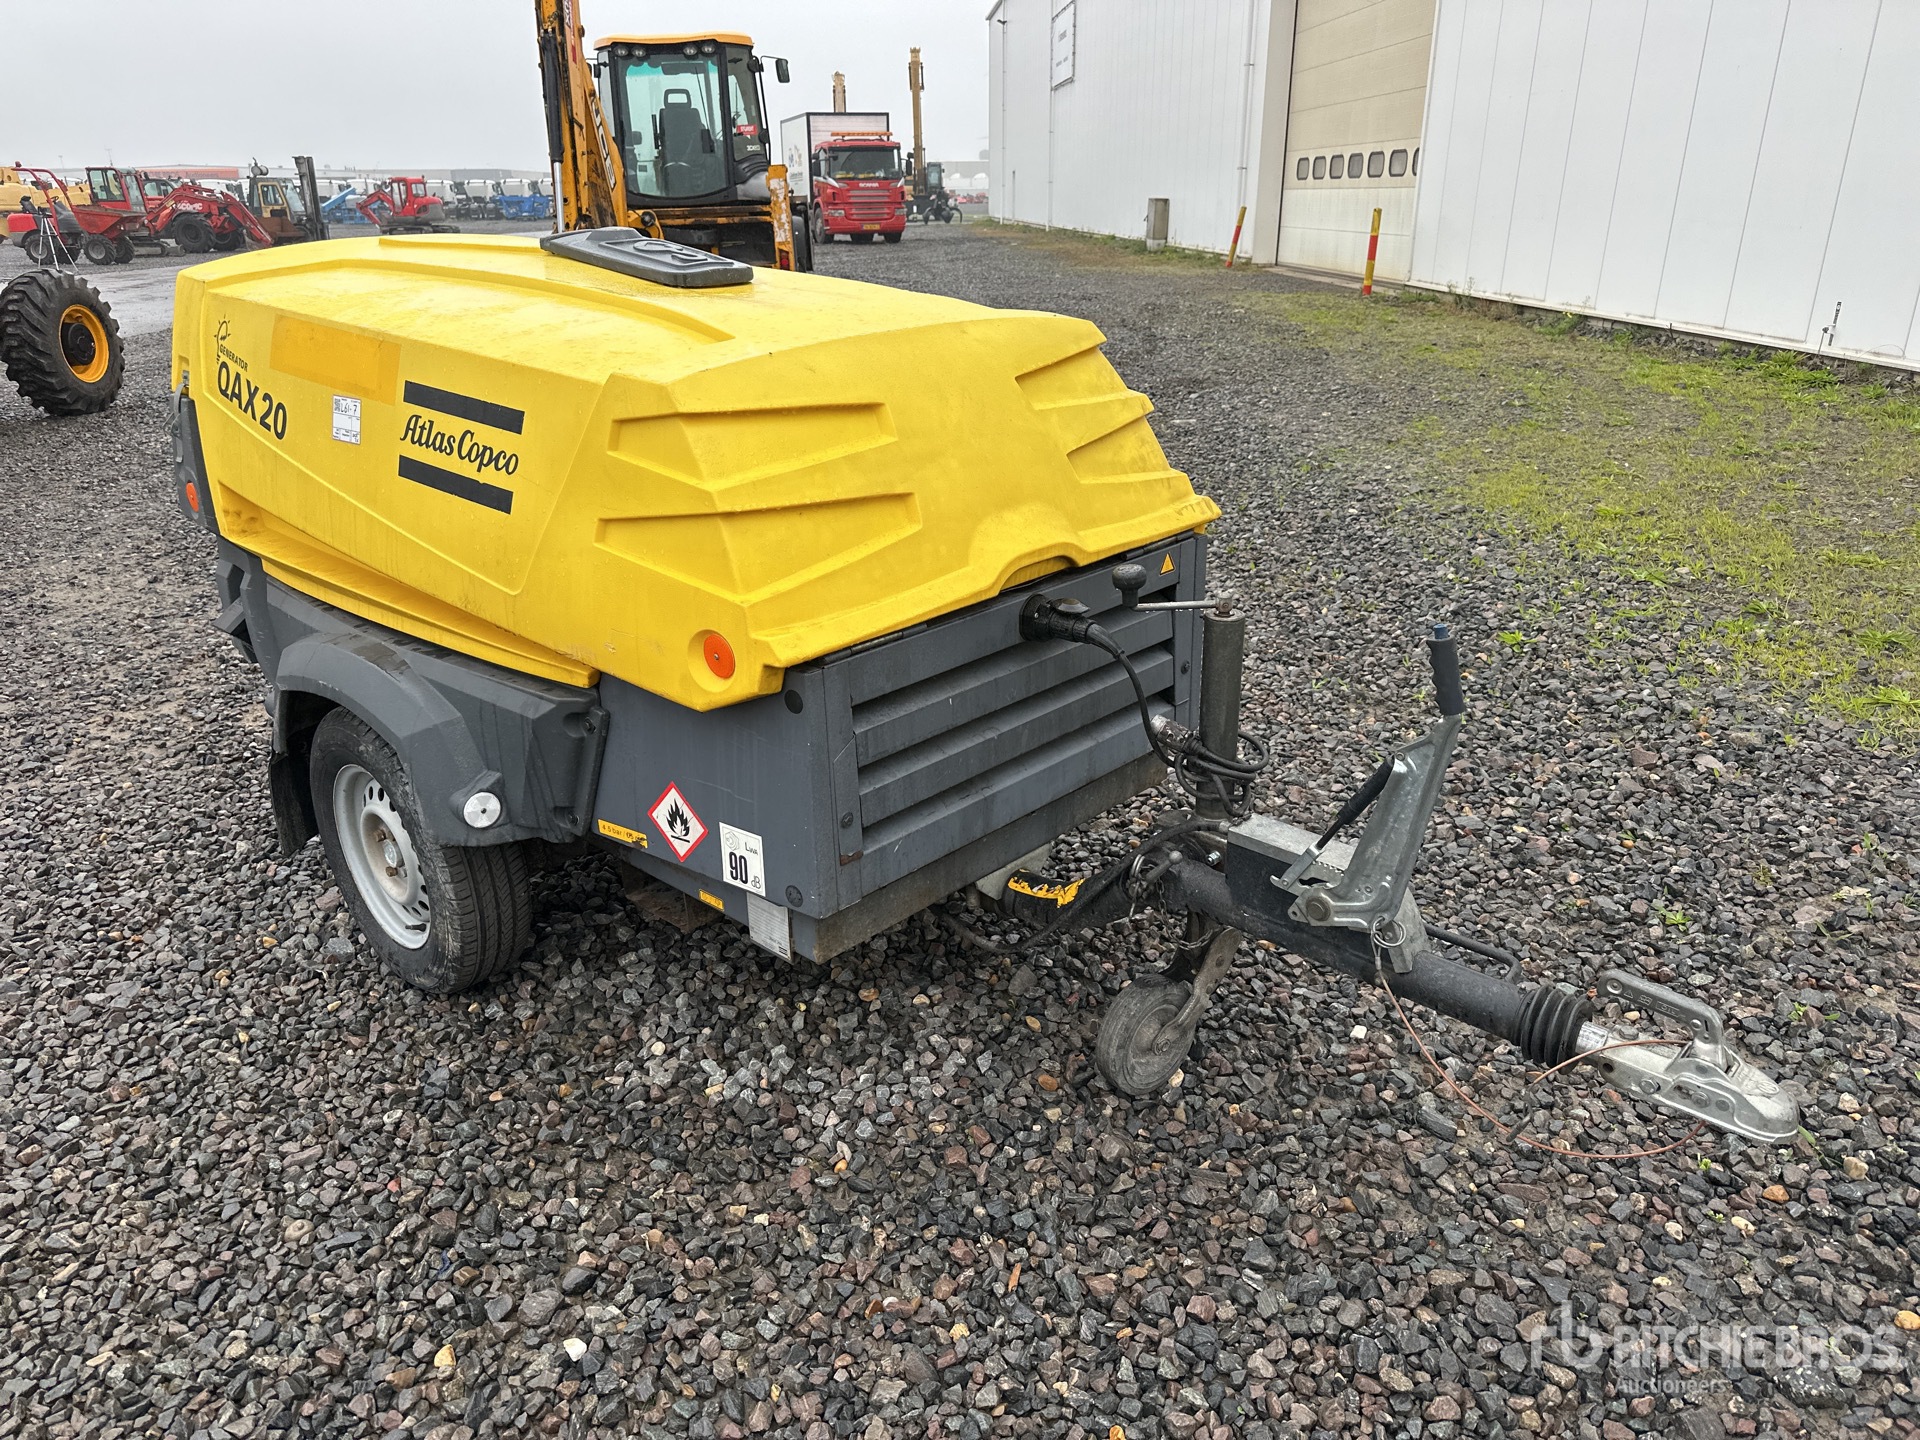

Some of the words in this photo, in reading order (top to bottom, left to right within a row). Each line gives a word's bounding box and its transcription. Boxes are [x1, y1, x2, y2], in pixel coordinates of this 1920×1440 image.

[219, 344, 248, 372] GENERATOR
[218, 361, 259, 420] QAX
[260, 393, 287, 440] 20
[400, 414, 456, 456] Atlas
[457, 430, 519, 475] Copco
[729, 852, 749, 885] 90
[751, 876, 762, 889] dB
